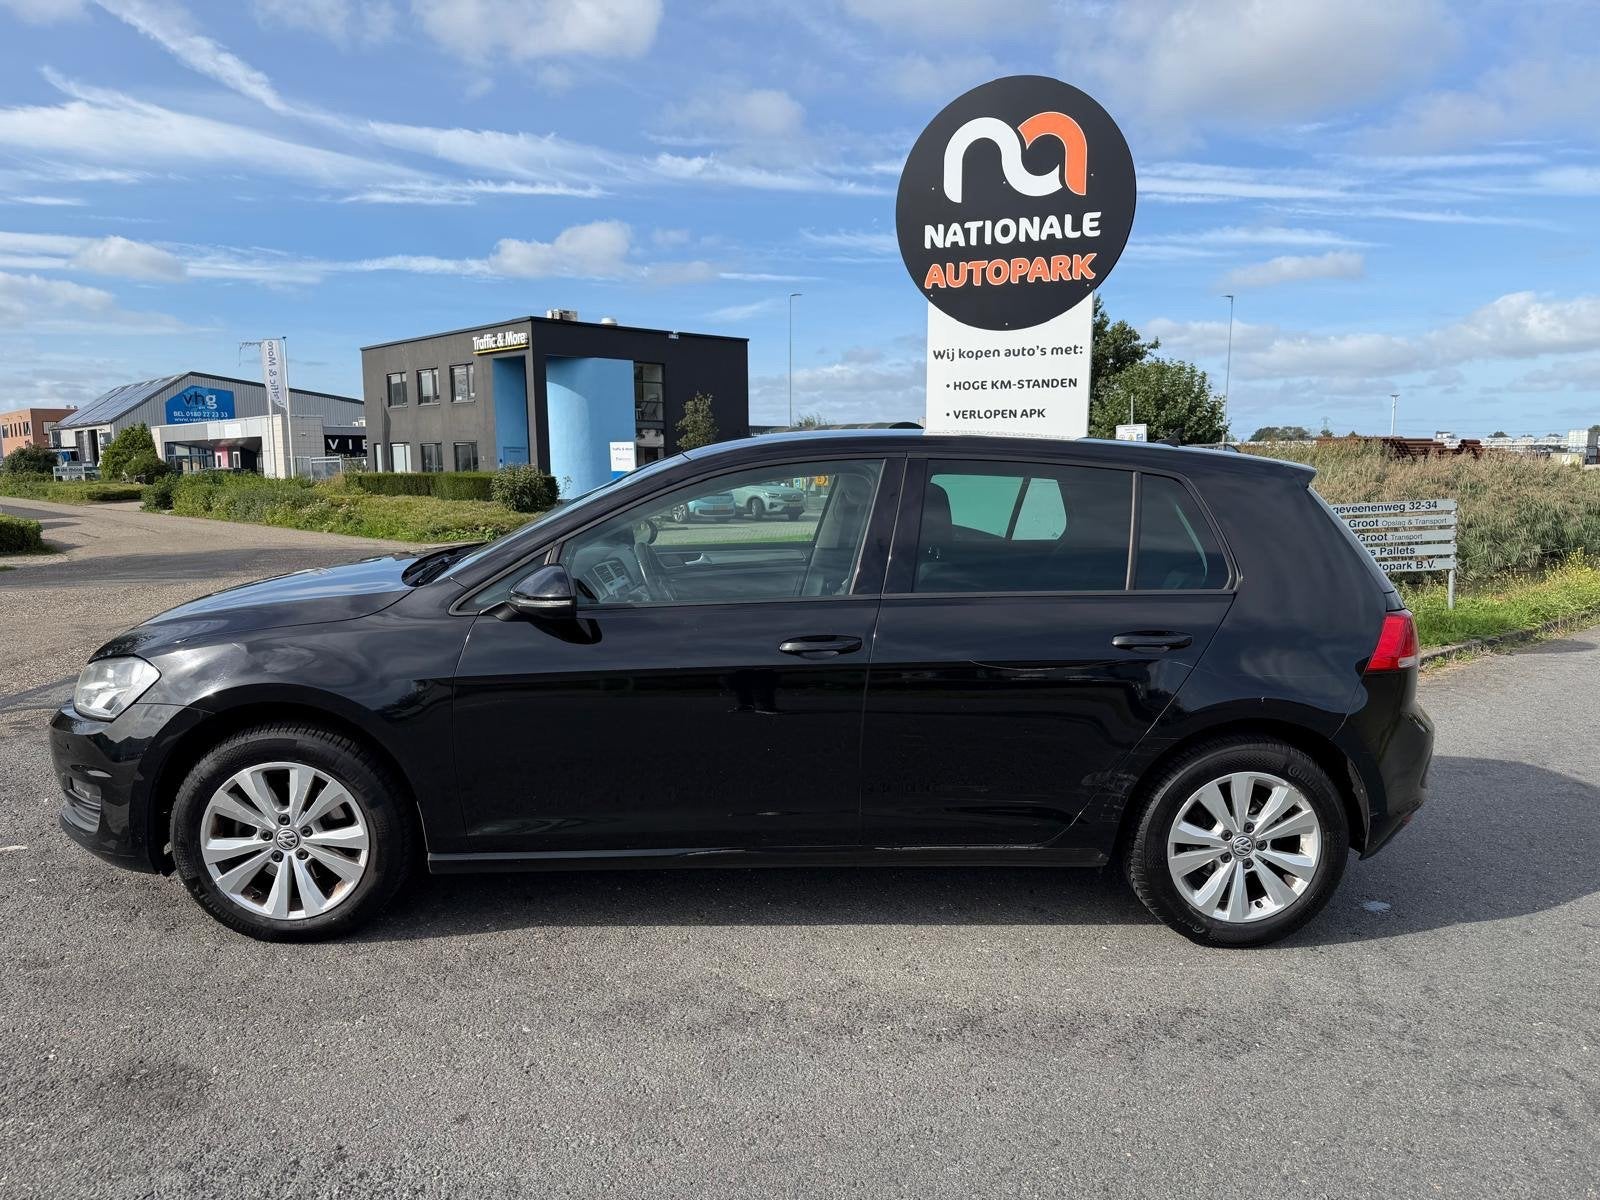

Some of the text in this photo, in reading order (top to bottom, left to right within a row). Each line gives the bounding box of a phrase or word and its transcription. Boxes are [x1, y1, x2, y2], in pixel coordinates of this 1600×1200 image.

[924, 211, 1102, 249] NATIONALE
[924, 252, 1097, 289] AUTOPARK
[472, 331, 528, 350] Traffic & More
[933, 344, 1083, 361] Wij kopen auto's met:
[953, 377, 1077, 390] HOGE KM-STANDEN
[183, 391, 217, 410] vhg
[953, 408, 1046, 419] VERLOPEN APK
[1409, 501, 1438, 510] 32-34
[1348, 519, 1379, 528] Groot
[1415, 517, 1447, 526] Transport
[1357, 532, 1423, 542] Groot Transport
[1380, 547, 1416, 556] Pallets
[1416, 560, 1436, 570] B.V.
